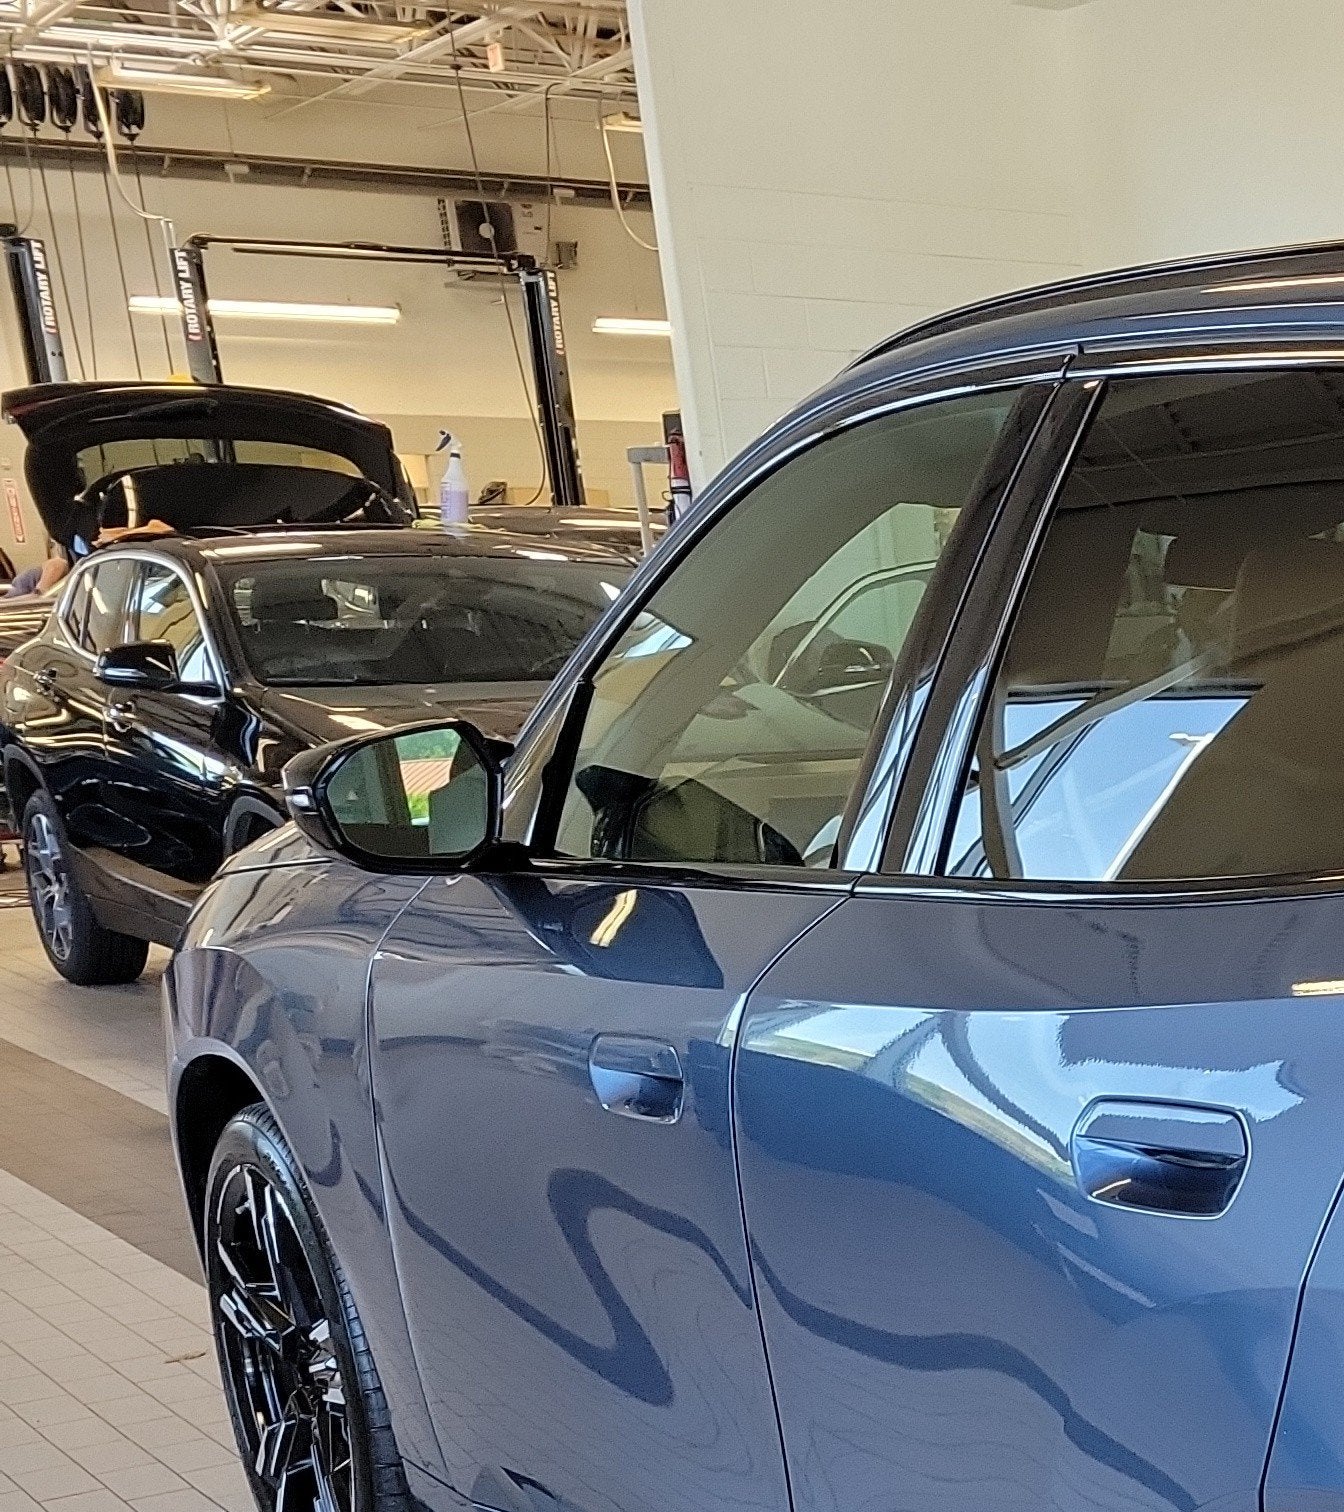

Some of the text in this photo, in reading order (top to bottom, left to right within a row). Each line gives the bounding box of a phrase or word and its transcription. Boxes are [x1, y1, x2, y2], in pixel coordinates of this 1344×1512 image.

[31, 240, 57, 326] ROTARY LIFT
[174, 250, 201, 333] ROTARY LIFT
[550, 301, 565, 349] ROTARY
